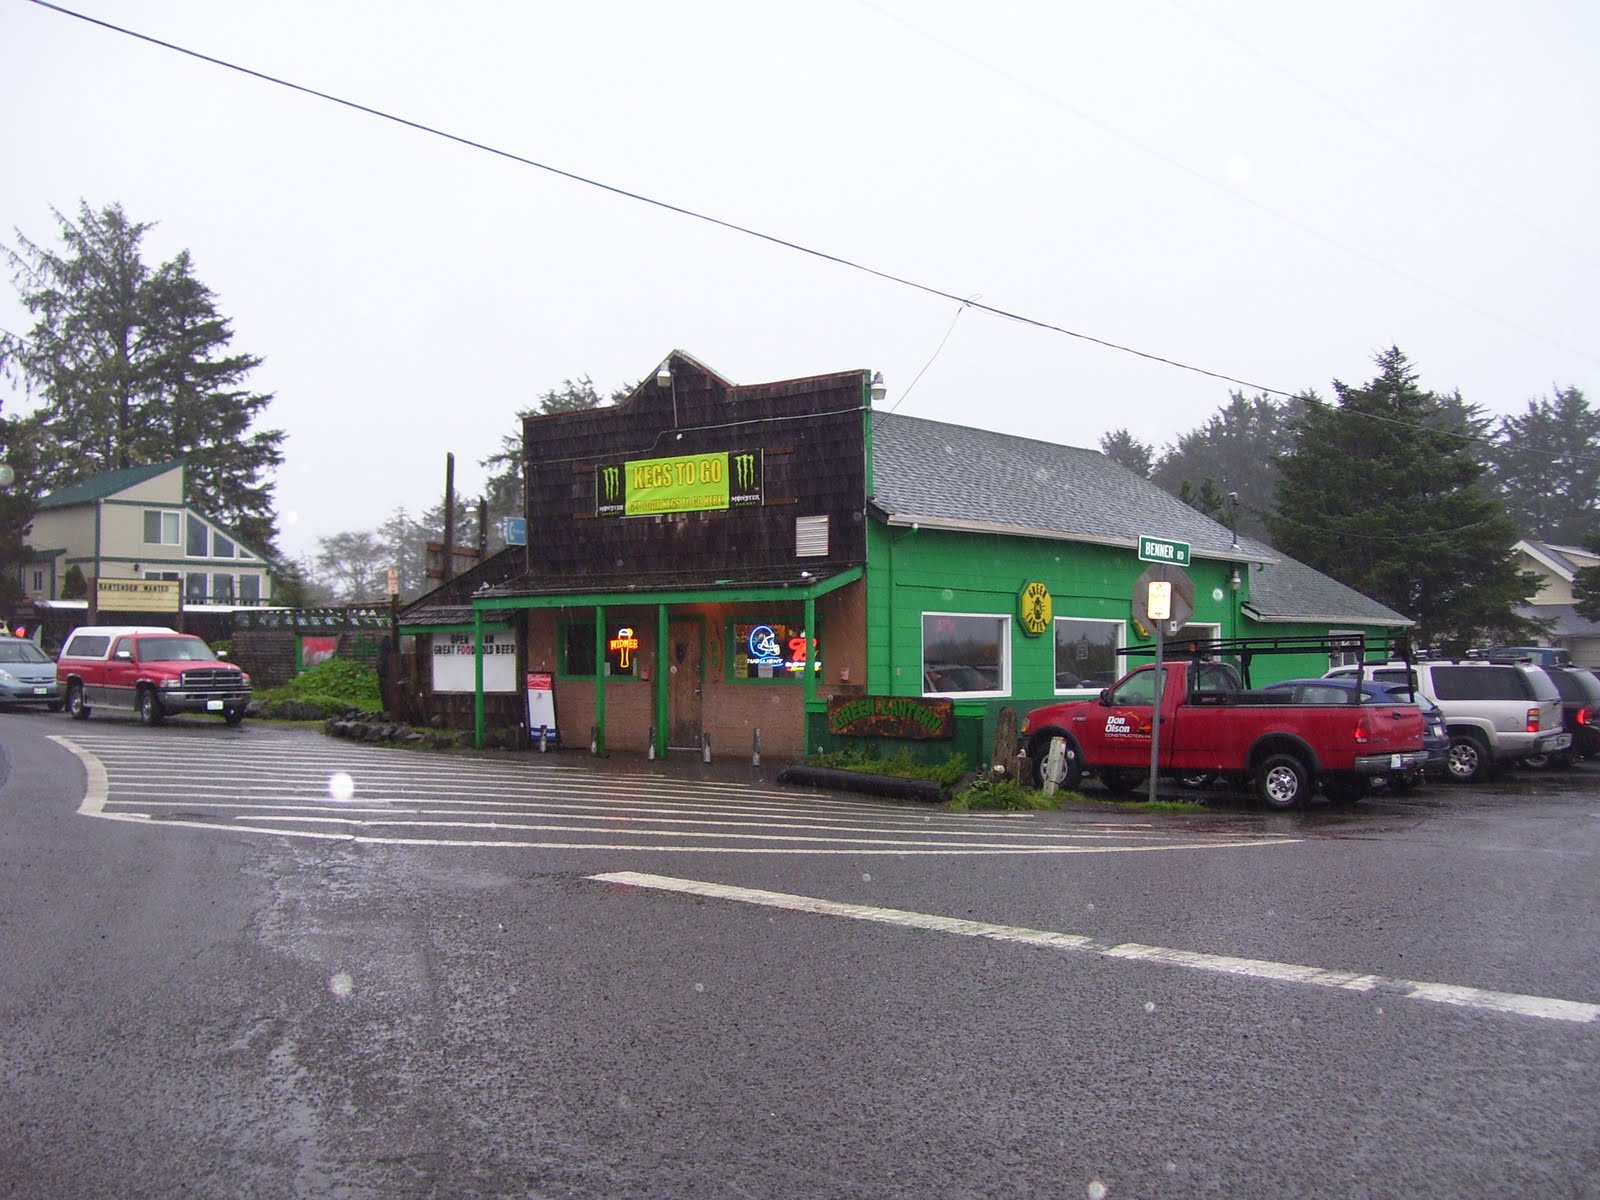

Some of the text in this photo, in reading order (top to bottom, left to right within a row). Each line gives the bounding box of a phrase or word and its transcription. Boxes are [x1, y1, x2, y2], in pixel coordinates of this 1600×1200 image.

[633, 459, 722, 490] KEGS TO GO
[1145, 541, 1184, 560] BENNER RD
[98, 583, 170, 592] BARTENDER WANTED
[450, 634, 468, 644] OPEN
[434, 645, 455, 655] GREAT
[495, 644, 515, 655] BEER
[832, 699, 942, 732] GREEN LANTERN
[1107, 715, 1126, 725] Don
[1105, 724, 1130, 733] Olson
